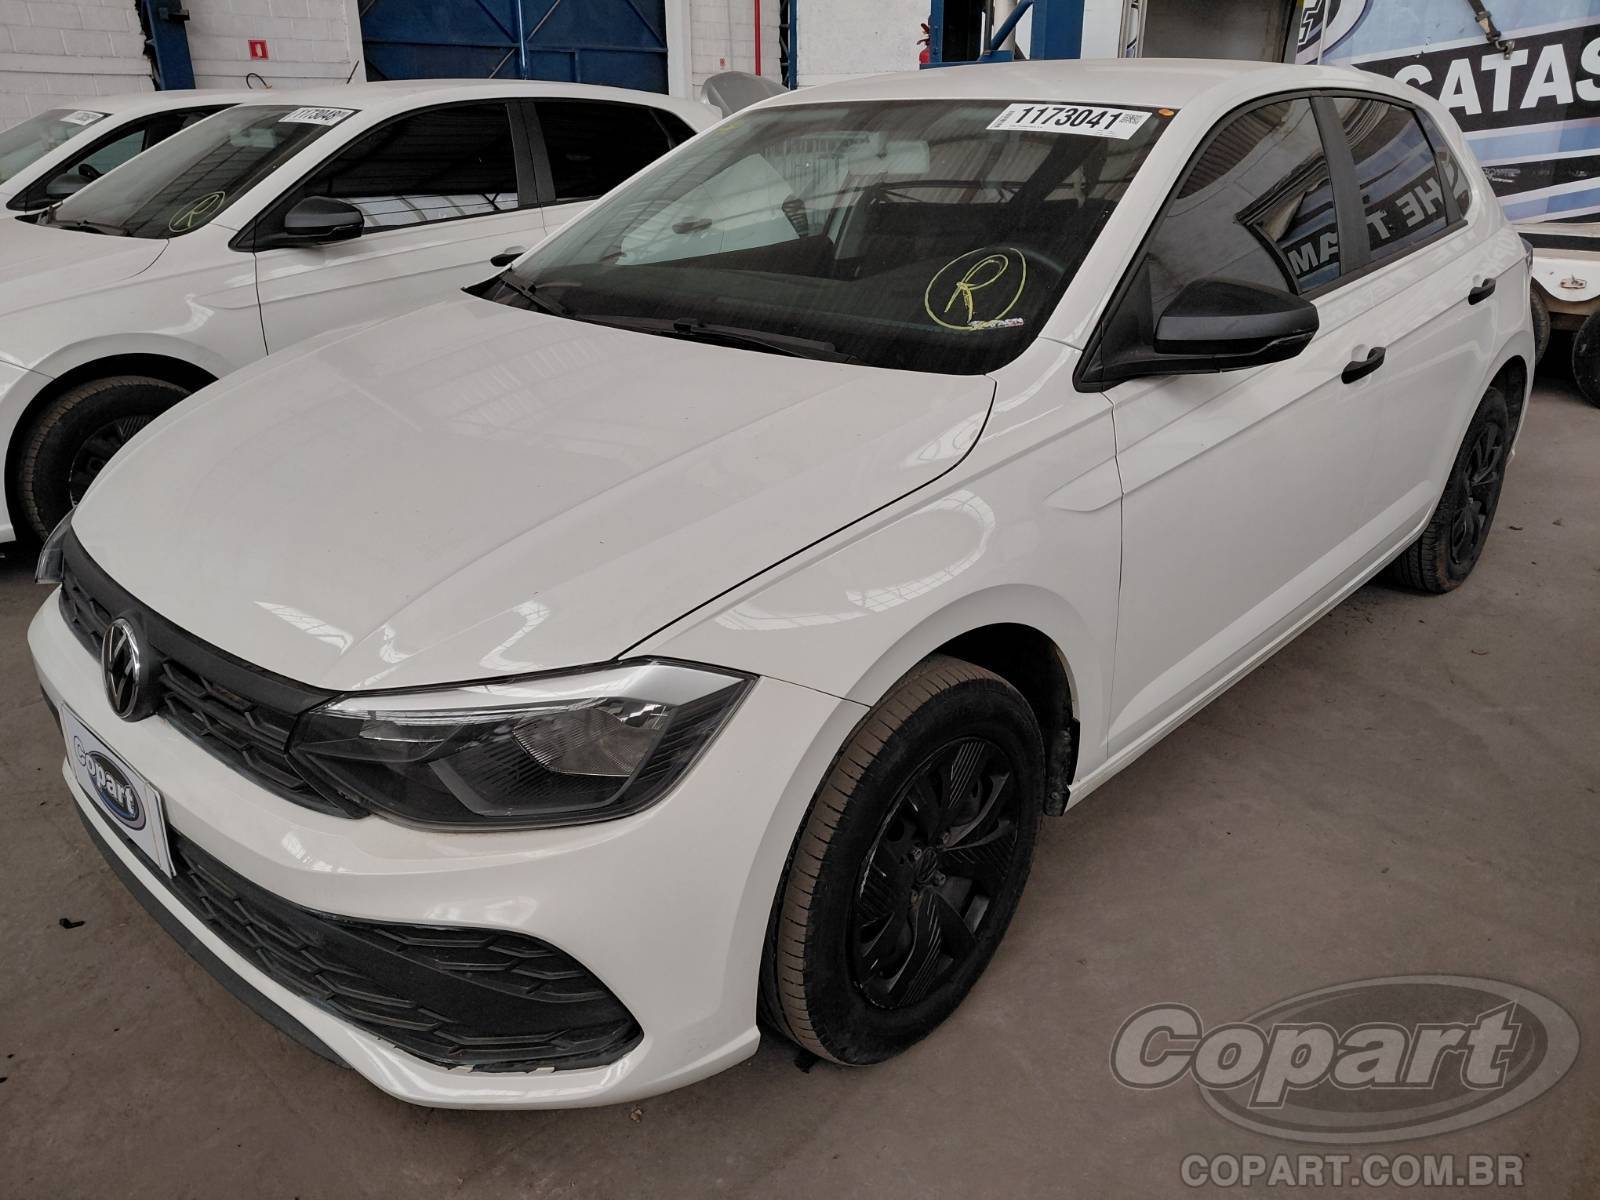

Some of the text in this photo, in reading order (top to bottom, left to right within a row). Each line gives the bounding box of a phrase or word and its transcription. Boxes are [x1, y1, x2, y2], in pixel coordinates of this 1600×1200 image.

[1016, 106, 1123, 130] 1173041
[944, 254, 1010, 325] R
[73, 735, 137, 817] Copart
